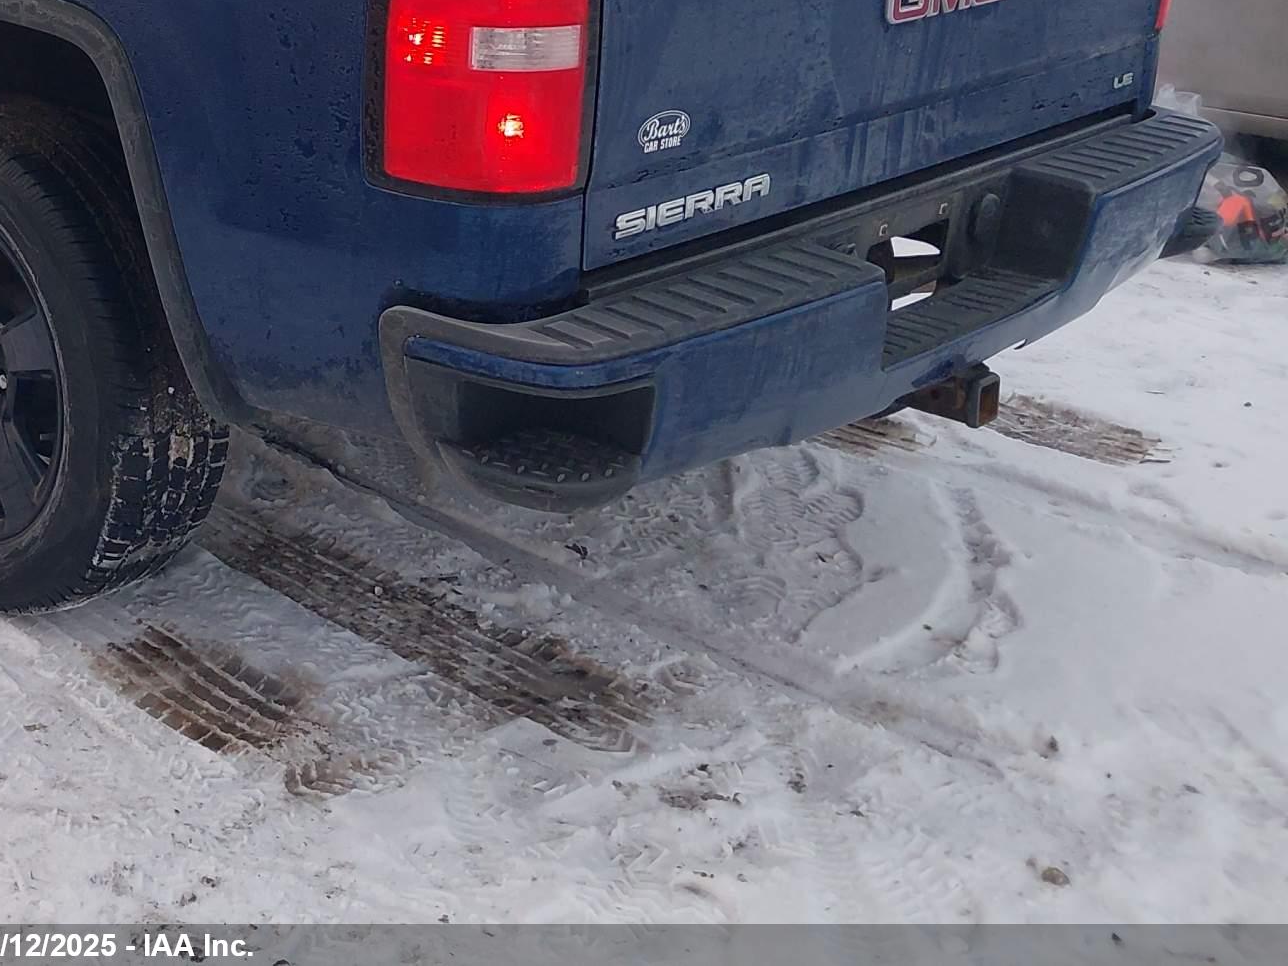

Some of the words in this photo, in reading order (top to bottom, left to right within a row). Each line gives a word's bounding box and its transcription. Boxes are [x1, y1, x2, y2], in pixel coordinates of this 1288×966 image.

[643, 115, 685, 141] Bart's
[643, 140, 659, 153] CAR
[660, 135, 681, 150] STORE
[615, 173, 771, 240] SIERRA
